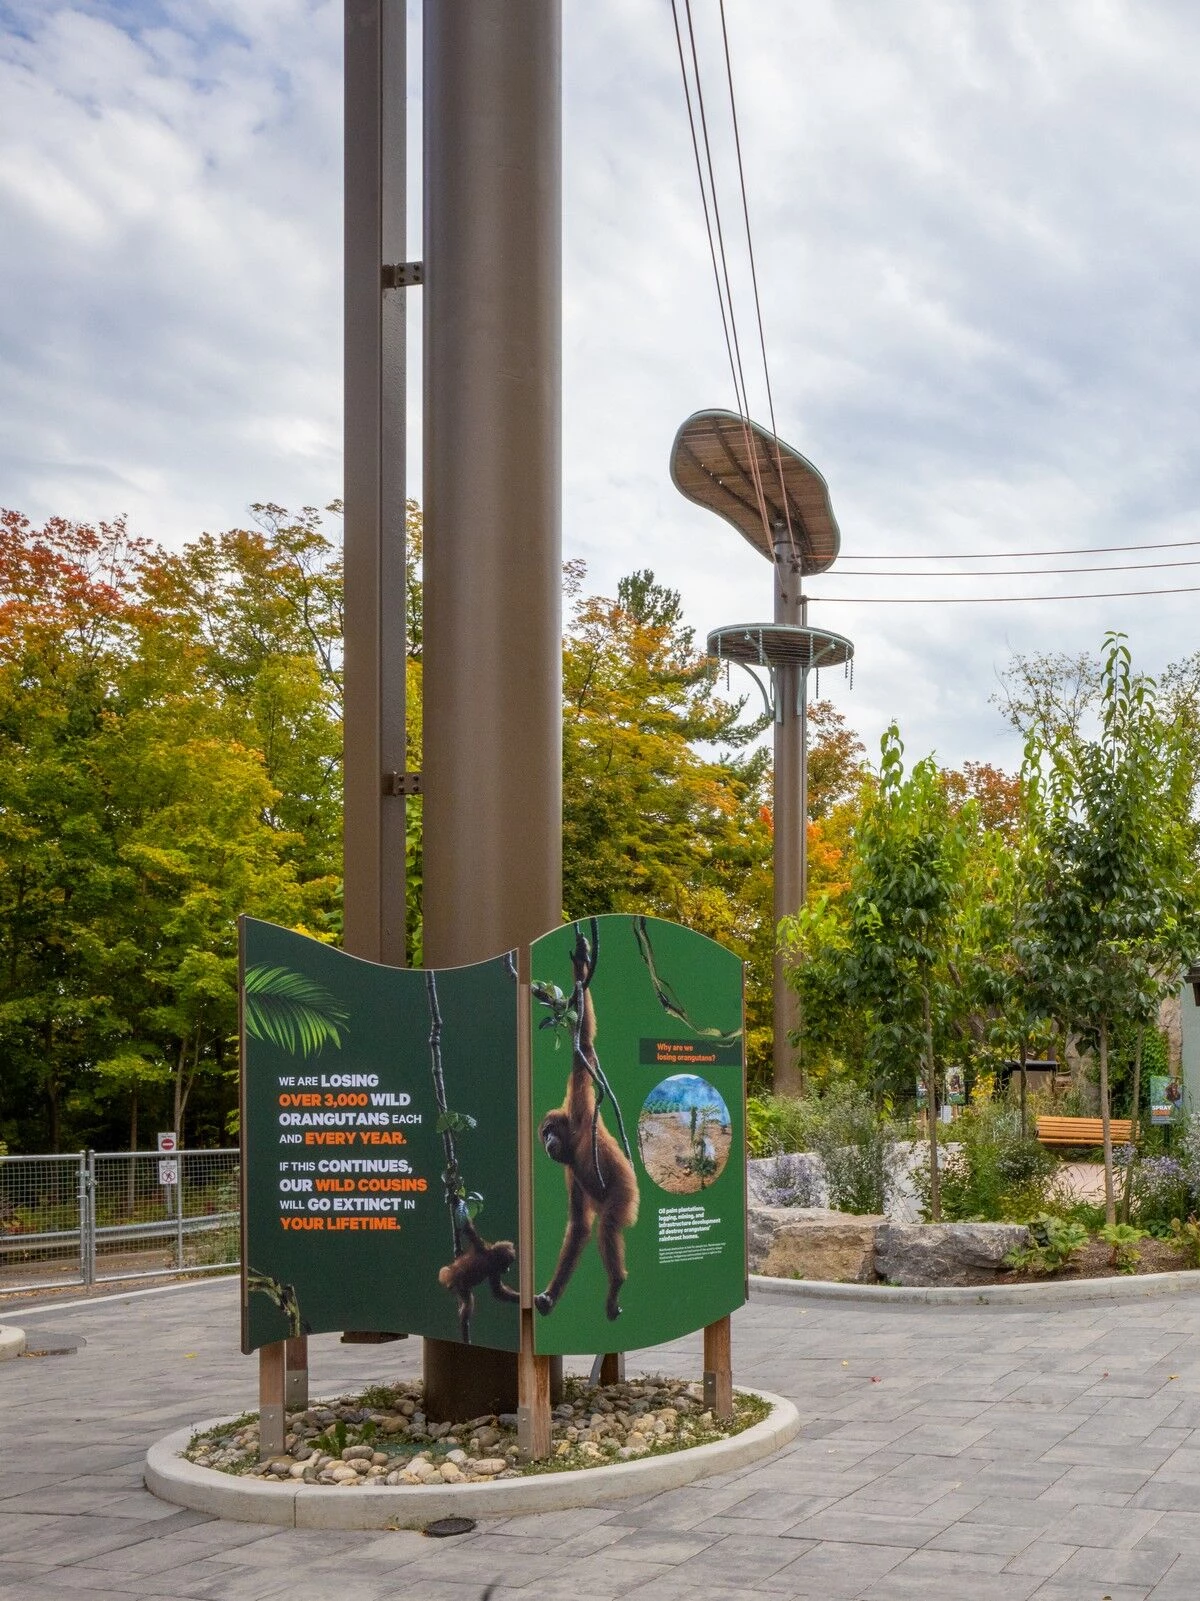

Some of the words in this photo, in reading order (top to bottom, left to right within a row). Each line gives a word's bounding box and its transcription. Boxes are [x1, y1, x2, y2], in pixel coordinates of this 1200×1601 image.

[657, 1042, 671, 1052] Why
[657, 1053, 676, 1062] losing
[678, 1054, 716, 1062] orangutans?
[279, 1077, 295, 1086] WE
[298, 1077, 318, 1086] ARE
[321, 1074, 380, 1087] LOSING
[279, 1094, 322, 1106] OVER
[324, 1094, 368, 1108] 3,000
[370, 1093, 411, 1106] WILD
[279, 1112, 390, 1126] ORANGUTANS
[392, 1114, 422, 1124] EACH
[279, 1134, 302, 1144] AND
[304, 1132, 356, 1144] EVERY
[360, 1132, 407, 1144] YEAR.
[280, 1162, 288, 1171] IF
[291, 1162, 316, 1172] THIS
[318, 1160, 412, 1174] CONTINUES,
[280, 1179, 312, 1192] OUR
[316, 1179, 355, 1192] WILD
[358, 1178, 428, 1192] COUSINS
[280, 1200, 304, 1210] WILL
[308, 1198, 330, 1211] GO
[334, 1198, 401, 1211] EXTINCT
[404, 1200, 415, 1209] IN
[280, 1217, 324, 1230] YOUR
[327, 1217, 401, 1230] LIFETIME.
